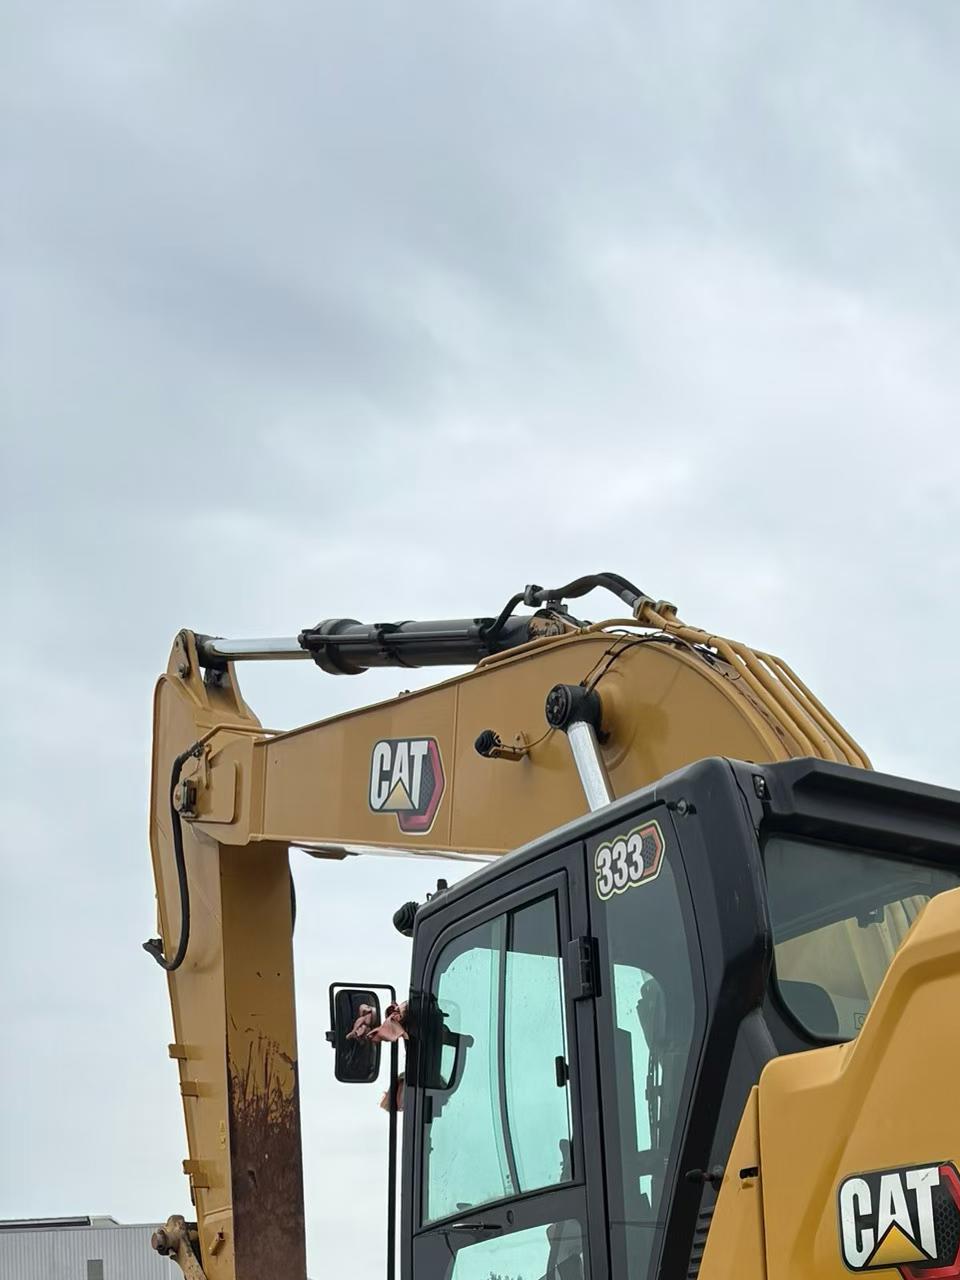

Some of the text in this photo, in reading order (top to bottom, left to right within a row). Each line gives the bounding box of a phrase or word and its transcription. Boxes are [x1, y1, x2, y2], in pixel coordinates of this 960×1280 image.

[370, 740, 429, 810] CAT
[597, 833, 644, 894] 333
[840, 1166, 940, 1268] CAT
